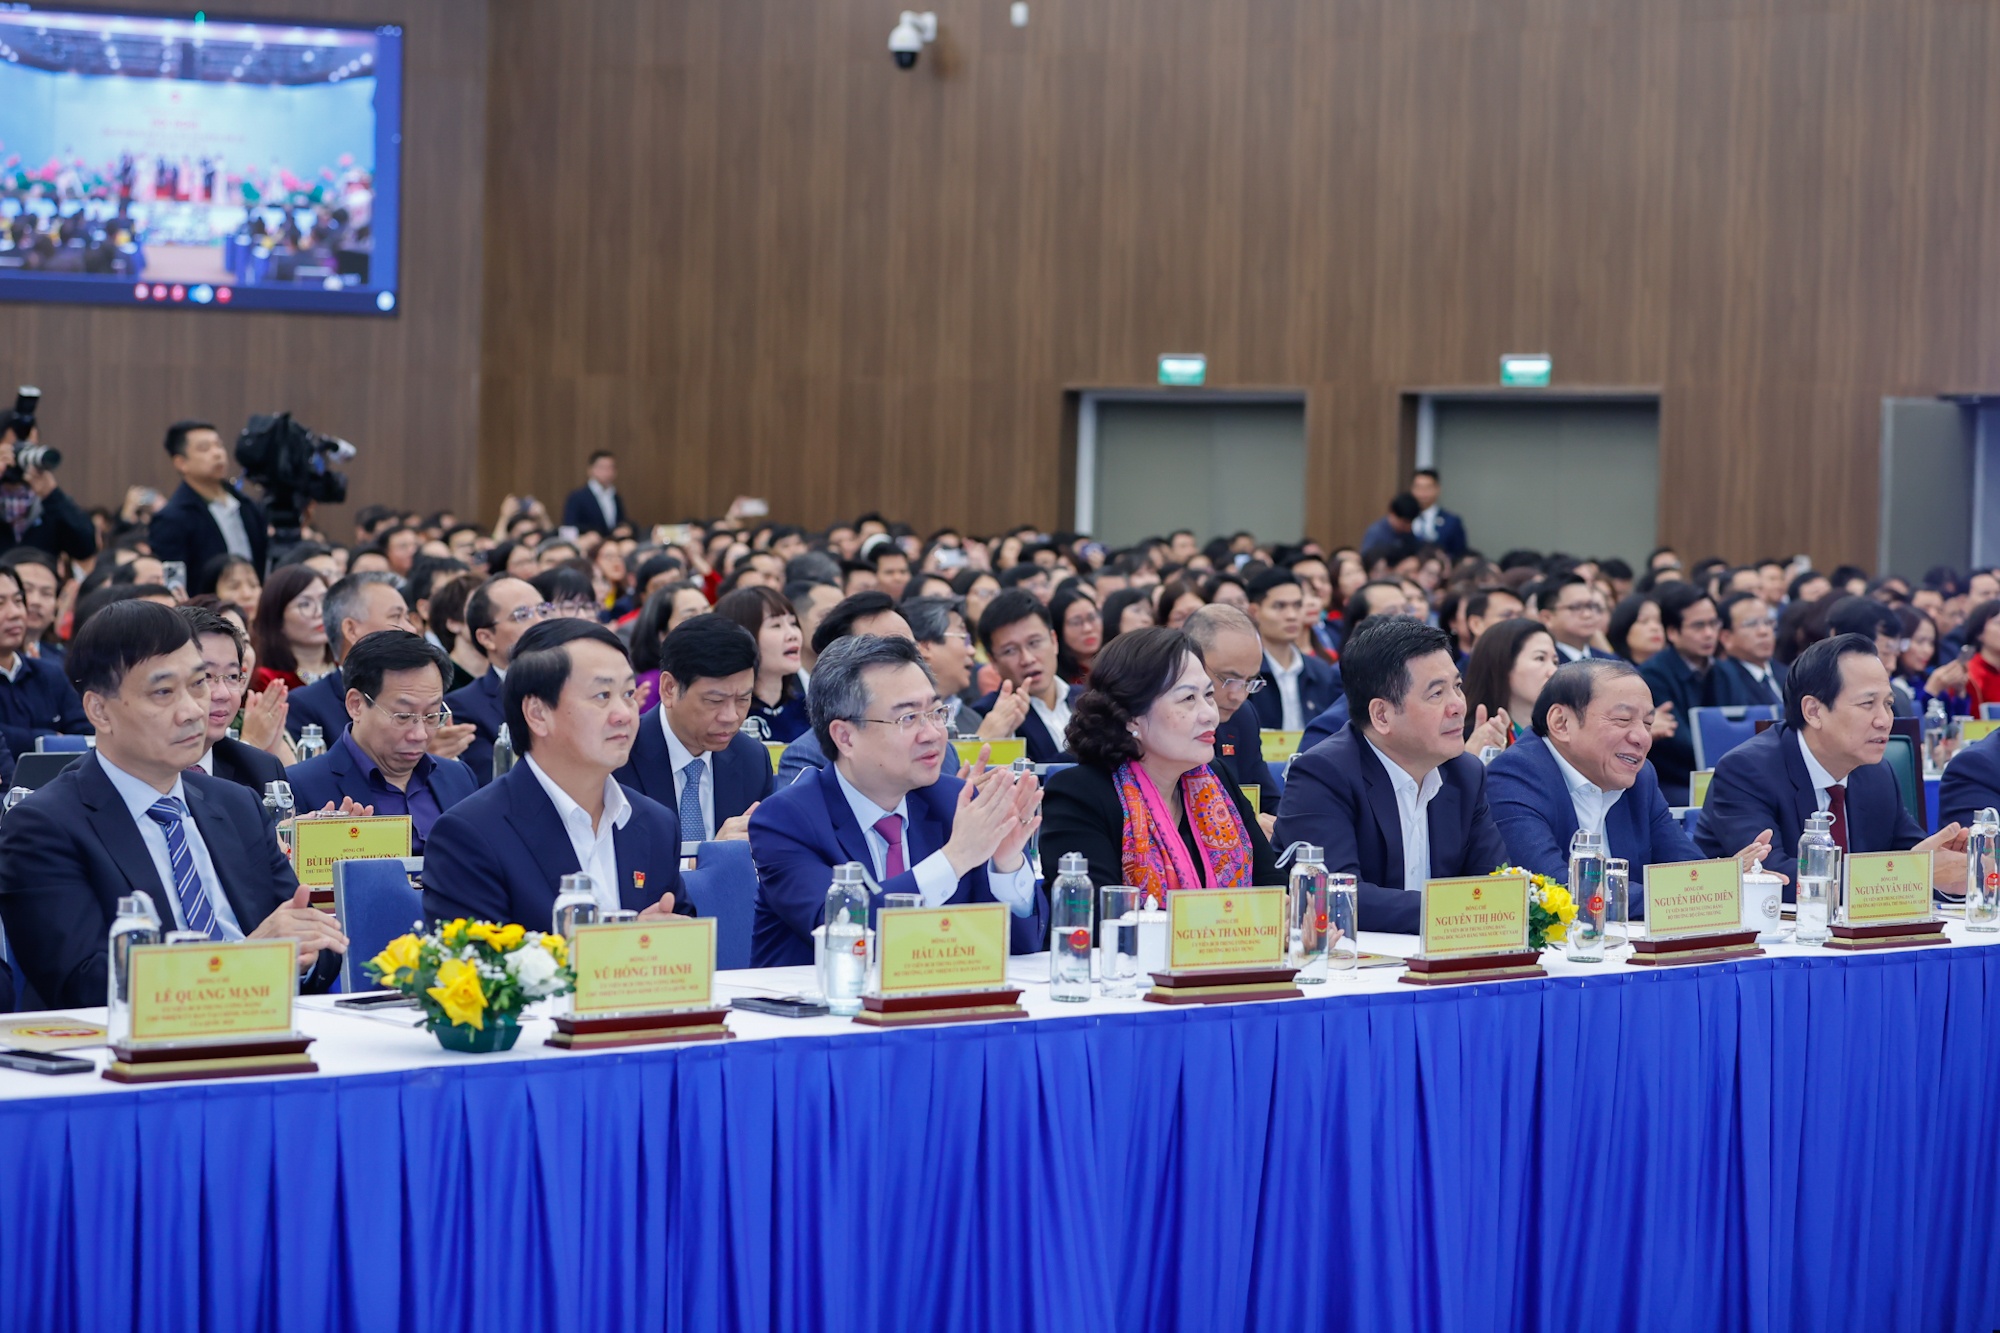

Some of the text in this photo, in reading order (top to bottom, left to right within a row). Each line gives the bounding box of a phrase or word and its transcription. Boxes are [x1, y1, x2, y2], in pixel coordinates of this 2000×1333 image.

[307, 855, 322, 866] BÙI
[1435, 910, 1515, 926] NGUYỄN THỊ HỒNG
[1176, 926, 1277, 940] NGUYỄN THANH NGHỊ
[155, 985, 270, 1003] LÊ QUANG MẠNH
